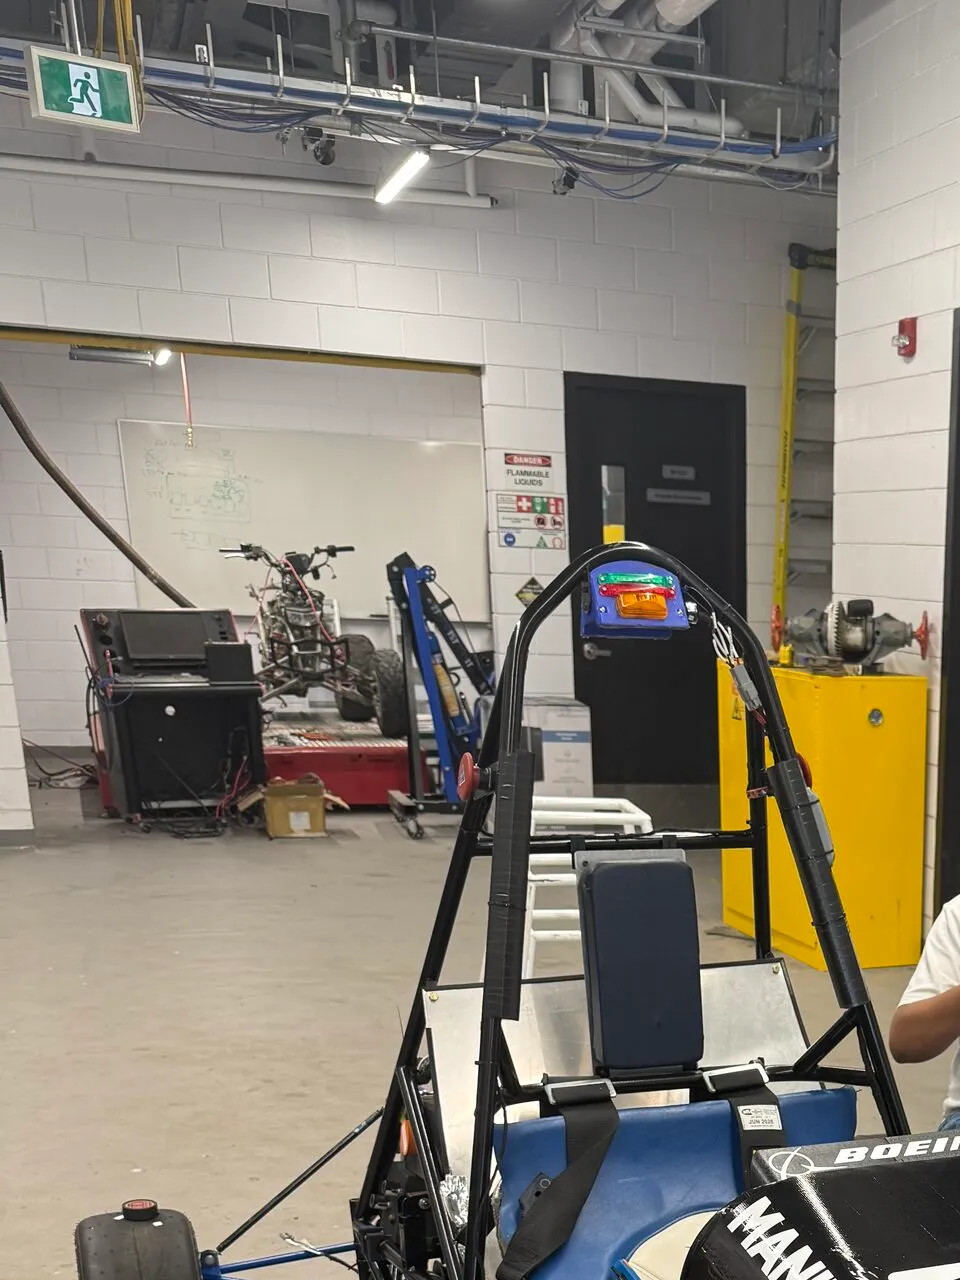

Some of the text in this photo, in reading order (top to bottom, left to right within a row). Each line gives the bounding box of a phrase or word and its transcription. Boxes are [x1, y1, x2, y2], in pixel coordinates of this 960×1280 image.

[513, 455, 543, 465] DANGER
[506, 469, 550, 478] FLAMMABLE
[514, 479, 543, 487] LIQUIDS
